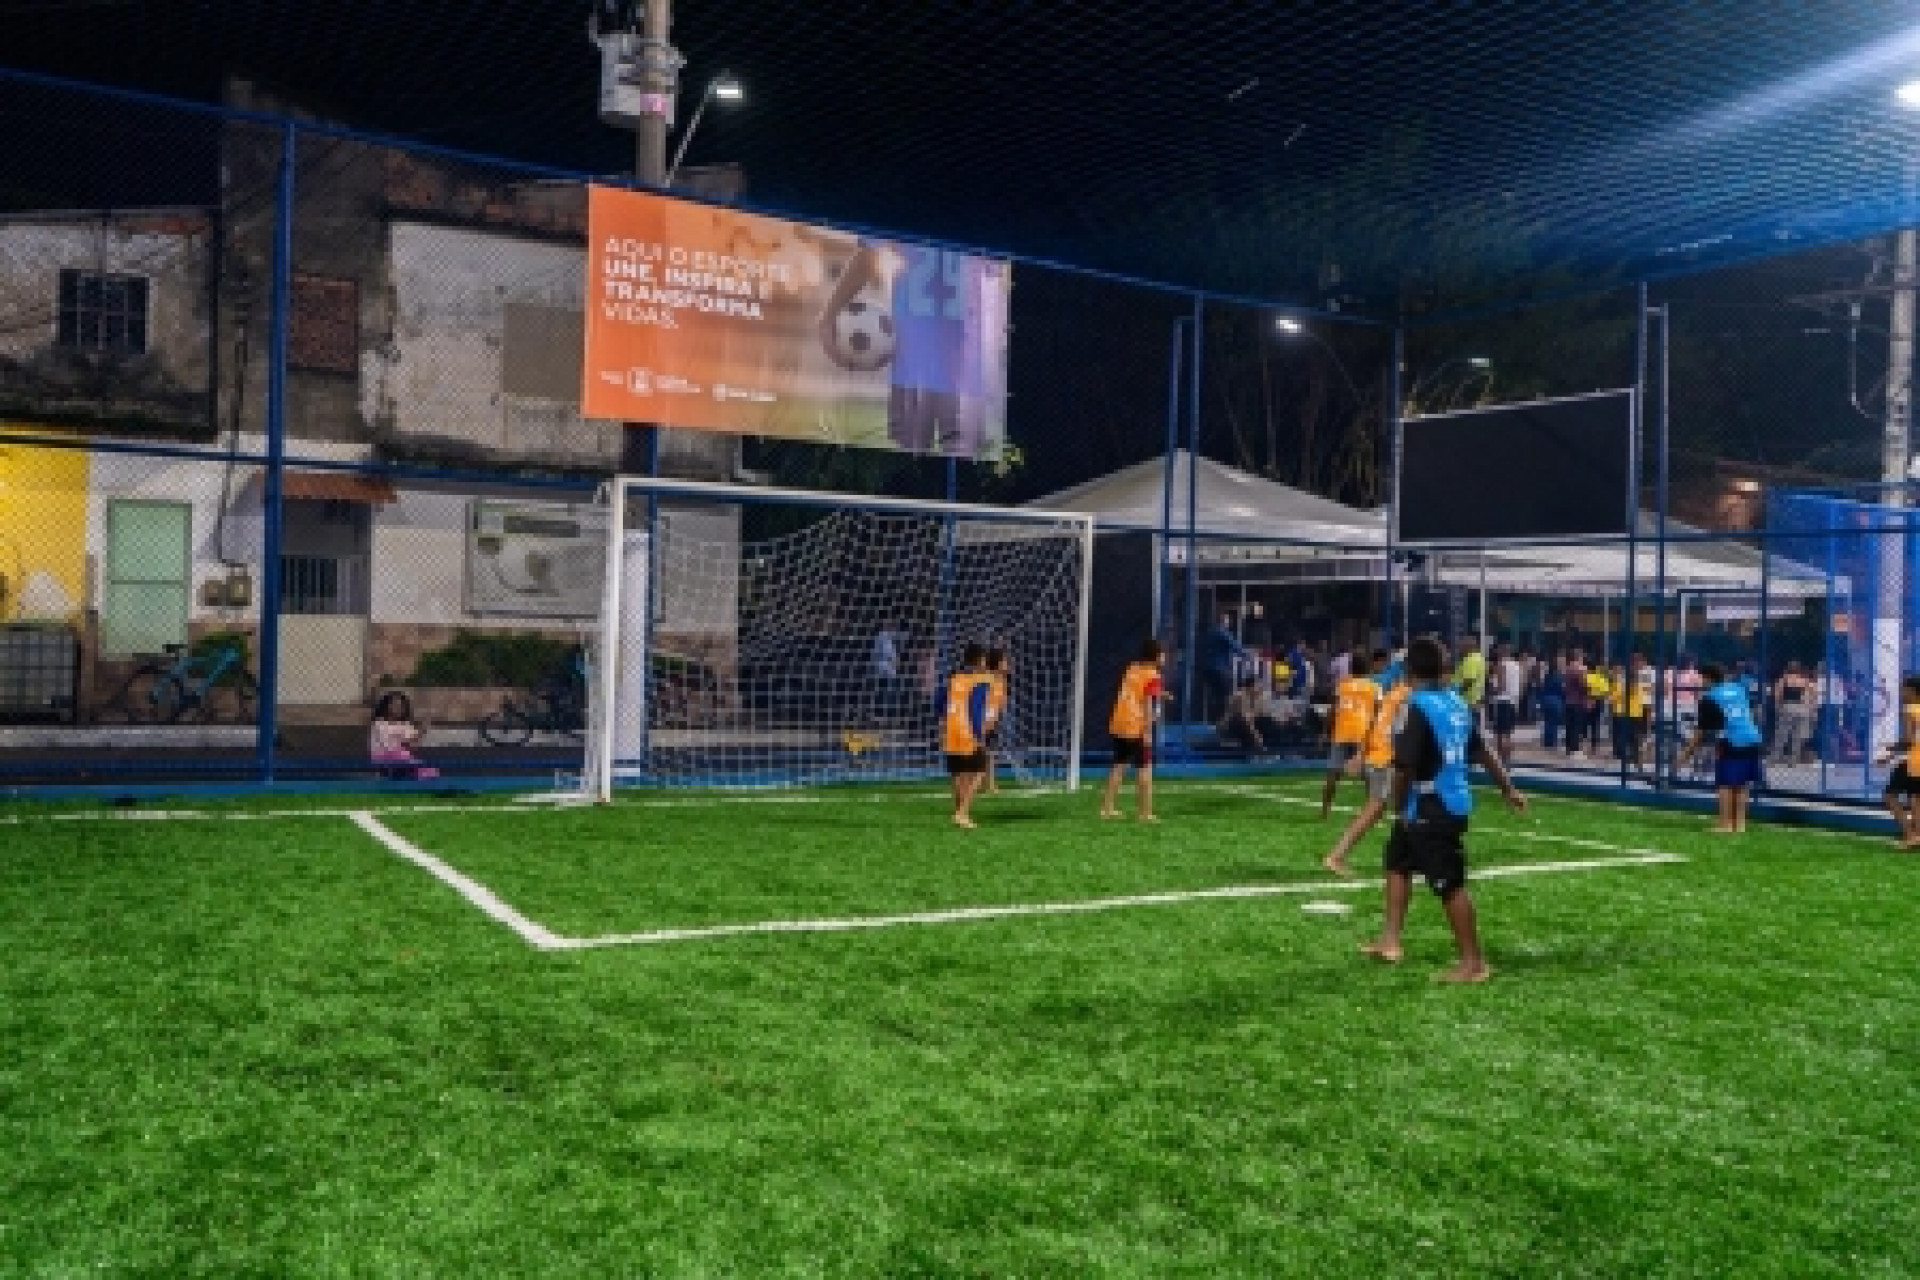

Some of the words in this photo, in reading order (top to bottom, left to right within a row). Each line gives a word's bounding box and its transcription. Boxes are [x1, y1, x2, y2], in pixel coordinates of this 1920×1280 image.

[605, 236, 662, 261] AQUI
[669, 246, 687, 265] O
[692, 251, 789, 282] ESPORTE
[605, 281, 763, 320] TRANSFORMA
[665, 268, 752, 296] INSPIRA
